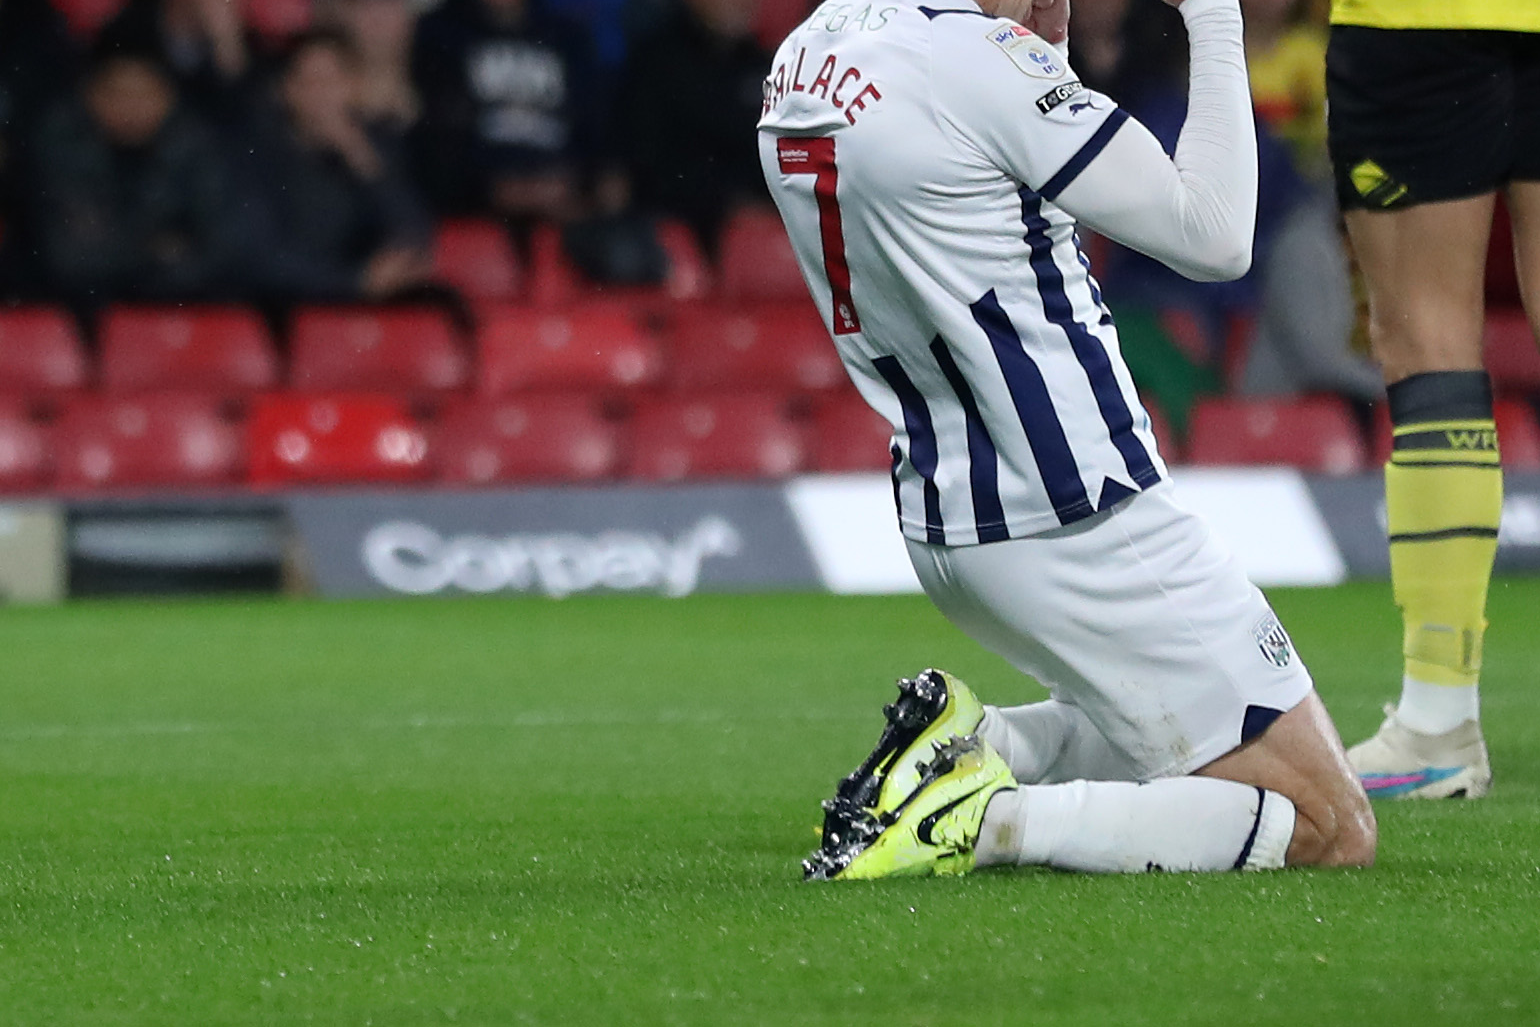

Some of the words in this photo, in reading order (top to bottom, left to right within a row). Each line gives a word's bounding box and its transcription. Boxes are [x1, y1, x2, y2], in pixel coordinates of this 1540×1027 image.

[808, 3, 898, 32] EGAS
[777, 137, 861, 335] 7
[362, 519, 702, 599] Corpay
